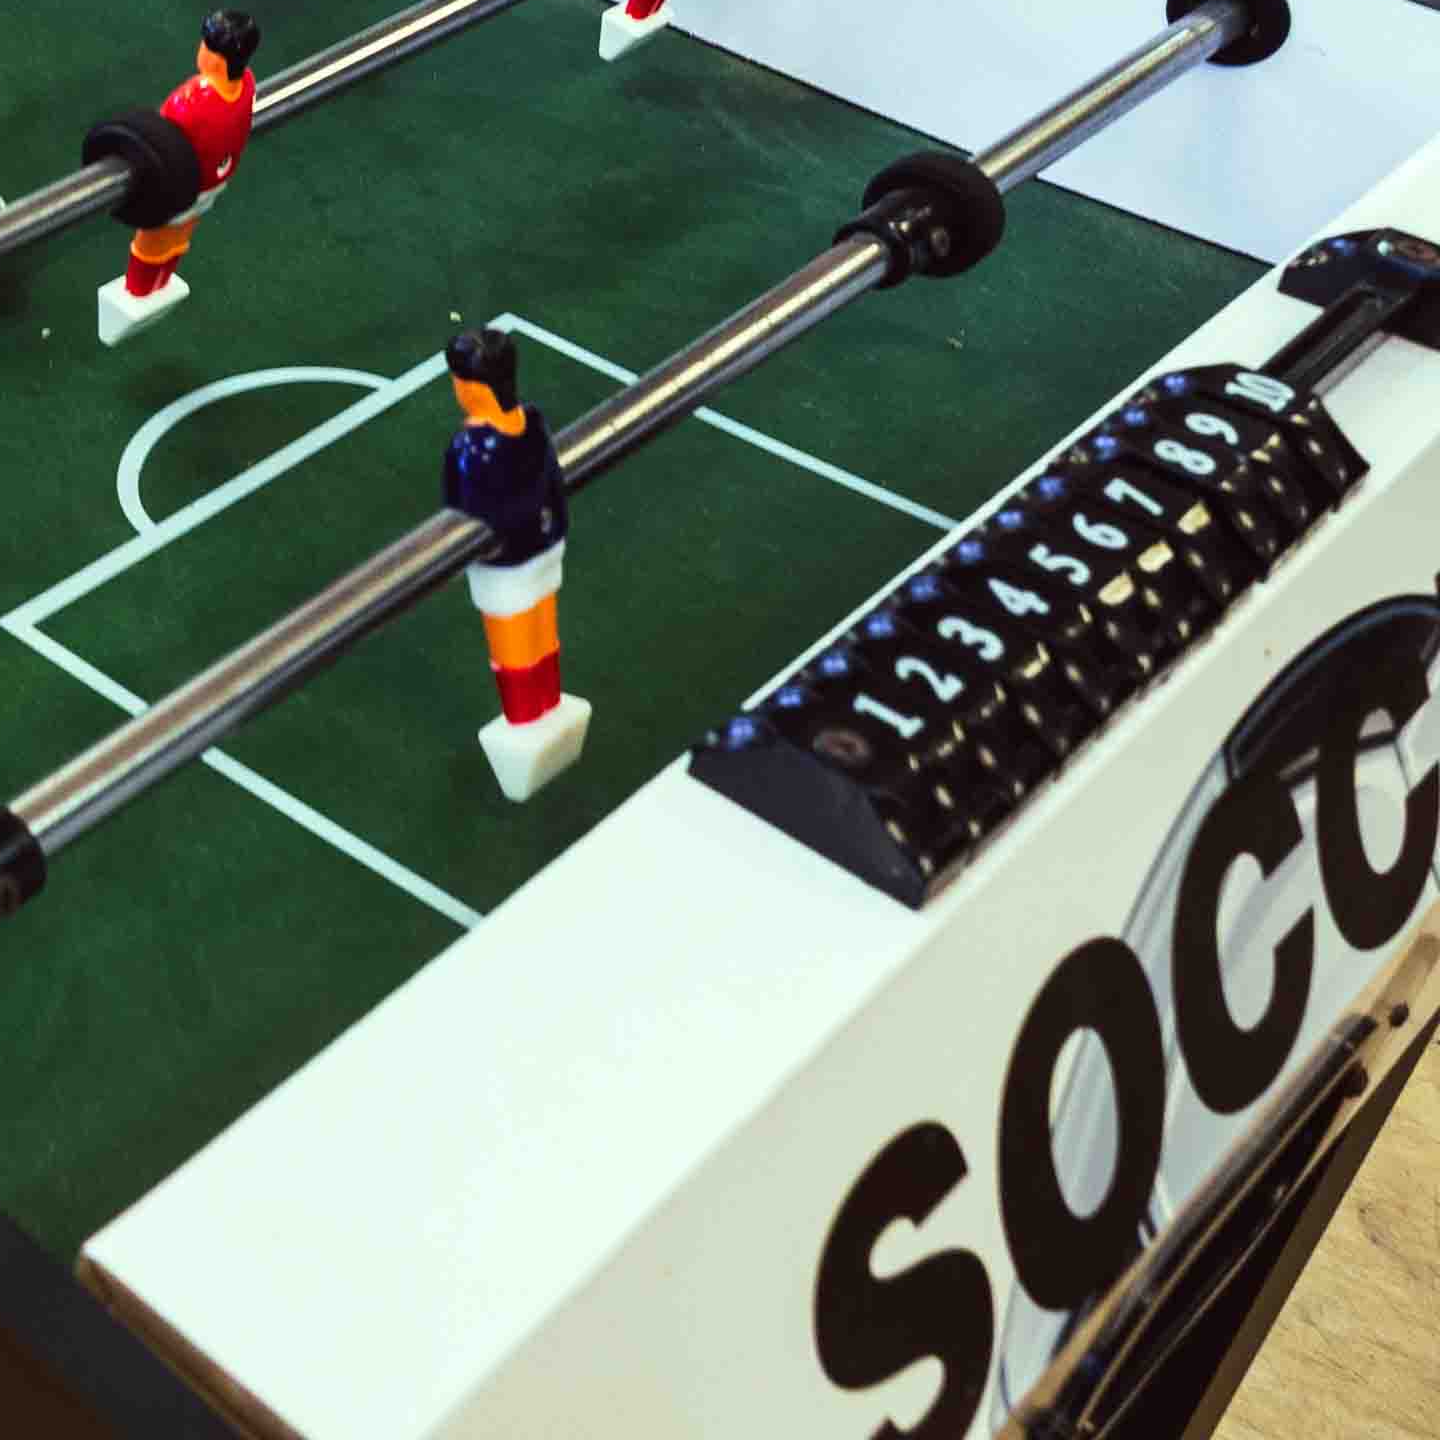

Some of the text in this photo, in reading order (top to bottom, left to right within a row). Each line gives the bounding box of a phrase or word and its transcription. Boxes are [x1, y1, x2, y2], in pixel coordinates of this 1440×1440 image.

[853, 371, 1295, 738] 1 2 3 4 5 6 7 8 9 10
[813, 570, 1440, 1440] SOCC
